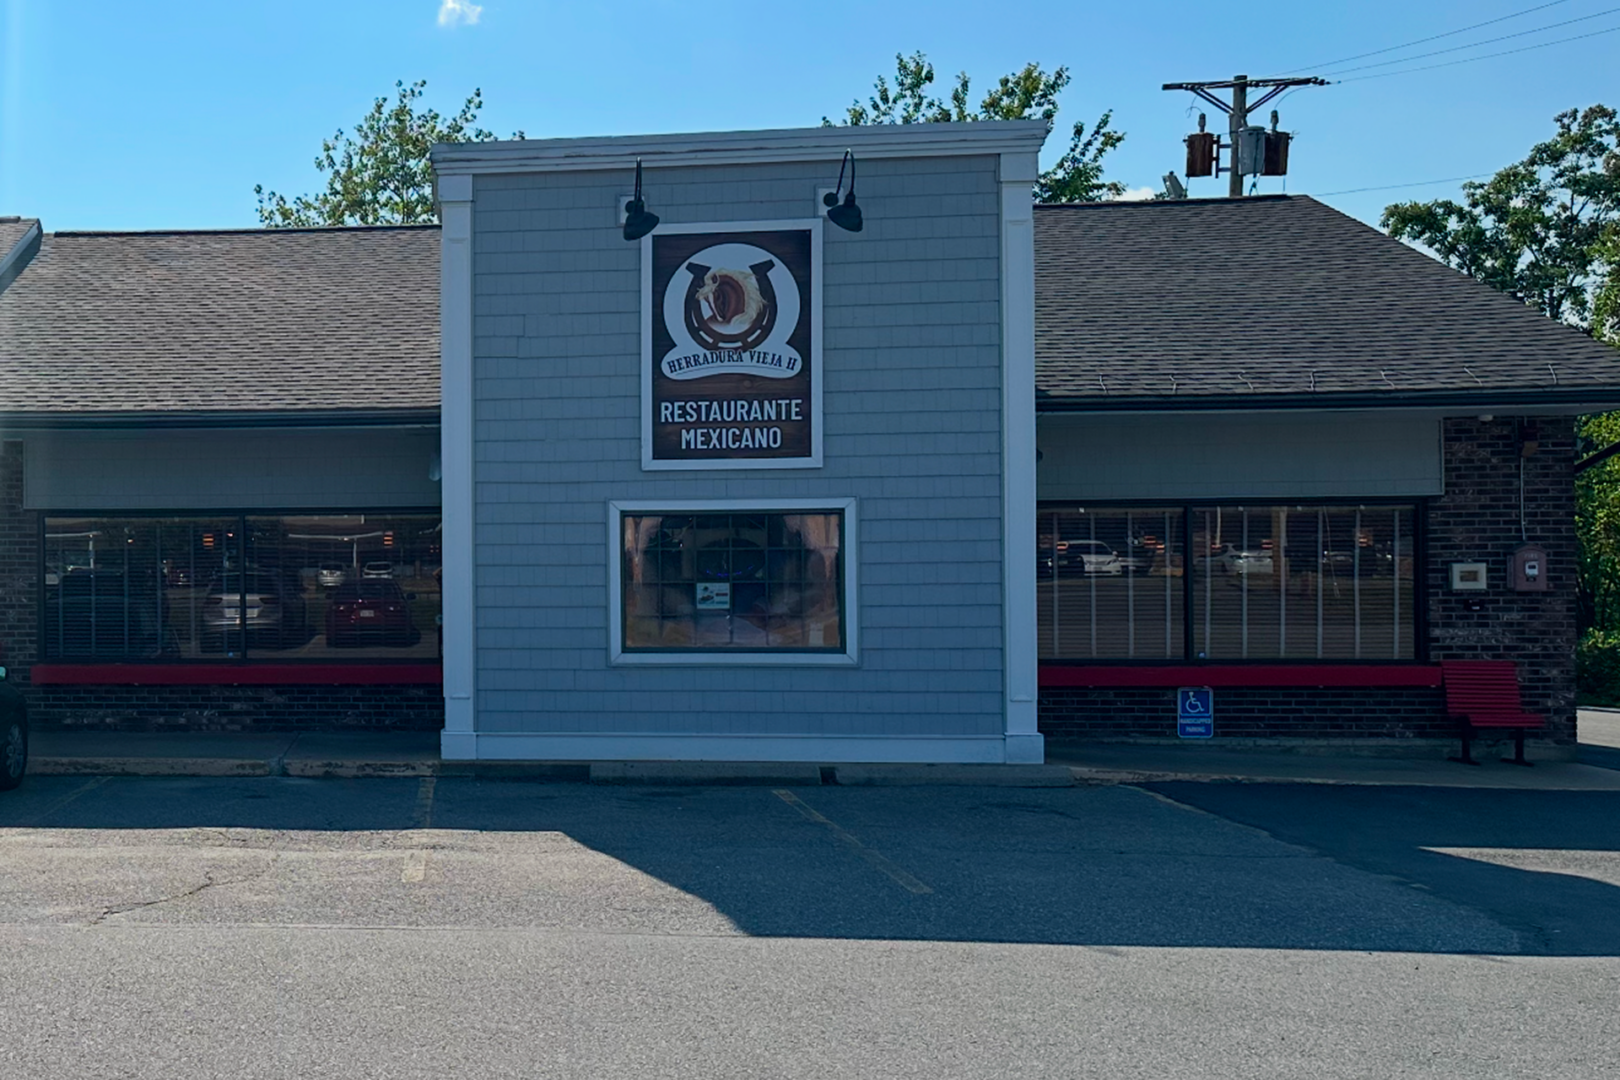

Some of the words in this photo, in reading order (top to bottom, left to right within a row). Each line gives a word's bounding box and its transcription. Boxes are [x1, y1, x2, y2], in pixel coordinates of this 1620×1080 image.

[666, 350, 744, 374] HERRADURA
[749, 350, 782, 367] VIEJA
[660, 399, 803, 423] RESTAURANTE
[680, 427, 782, 449] MEXICANO
